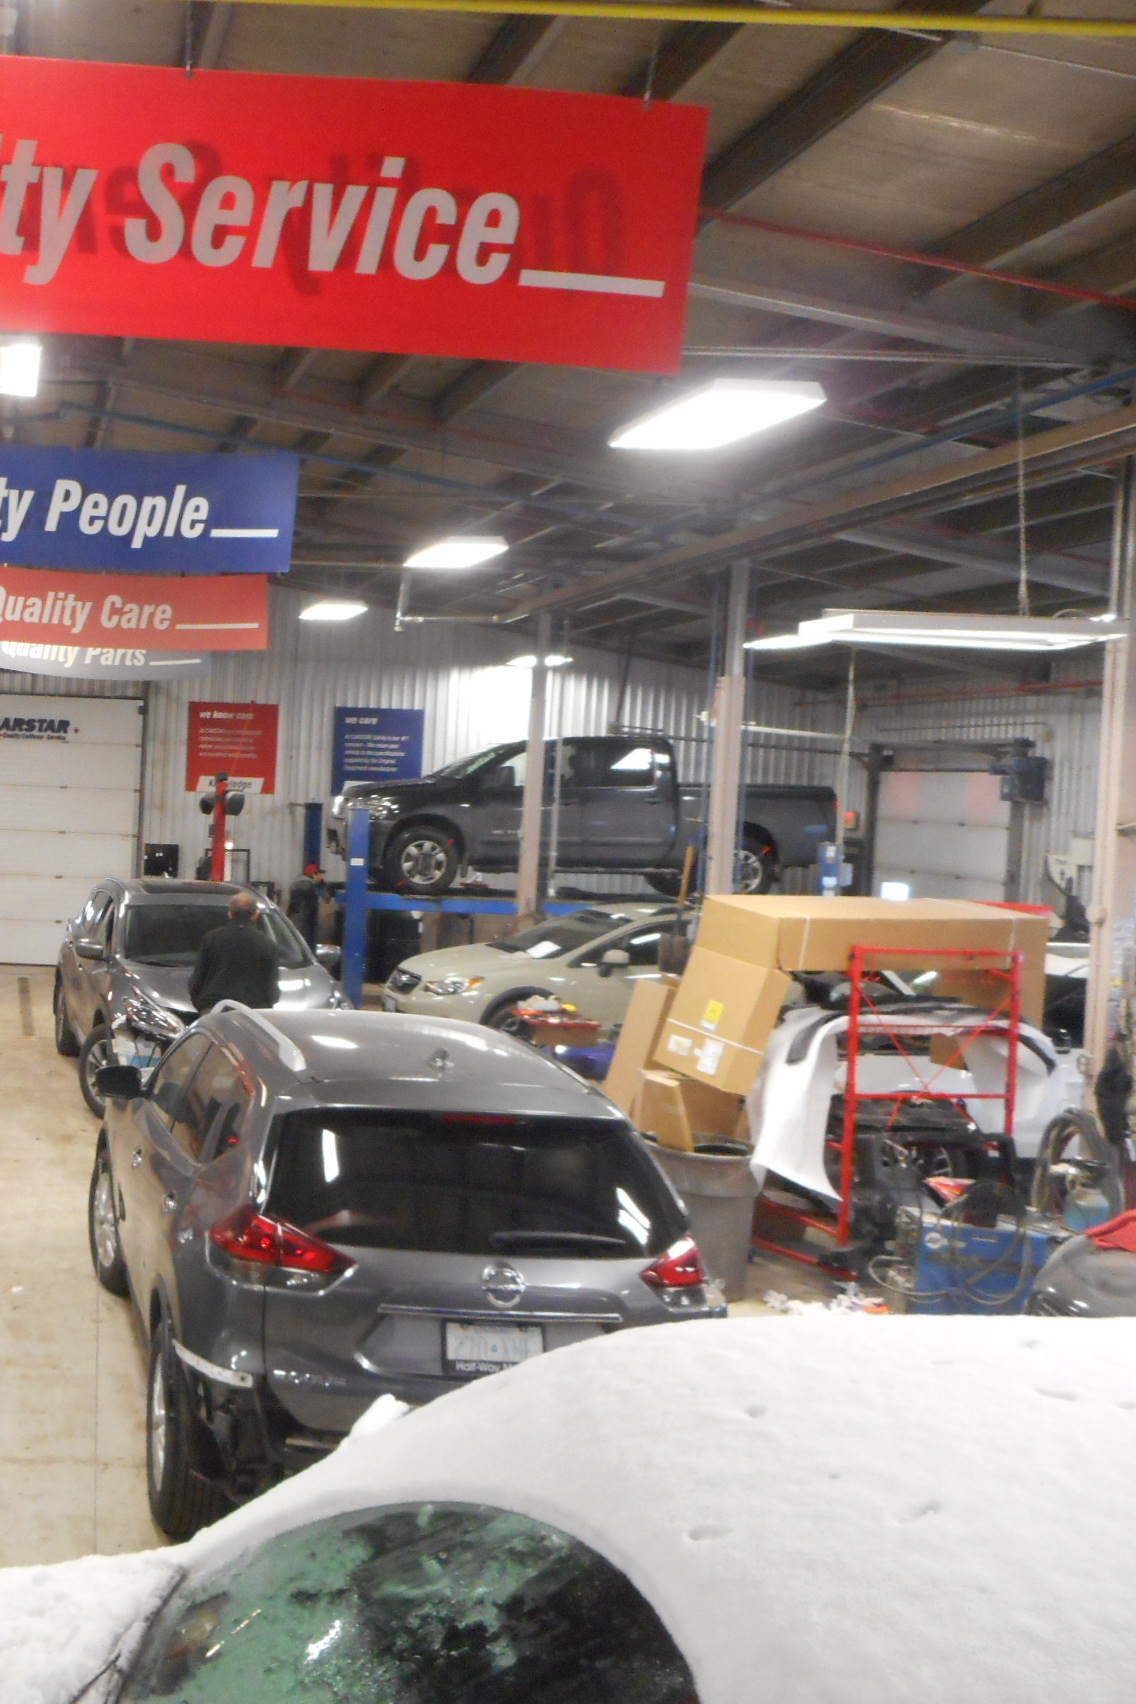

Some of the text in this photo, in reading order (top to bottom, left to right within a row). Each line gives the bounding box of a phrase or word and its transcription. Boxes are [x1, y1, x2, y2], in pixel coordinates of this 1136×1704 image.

[122, 142, 520, 286] Service
[44, 479, 210, 548] People
[101, 595, 173, 631] Care
[84, 648, 146, 666] Parts
